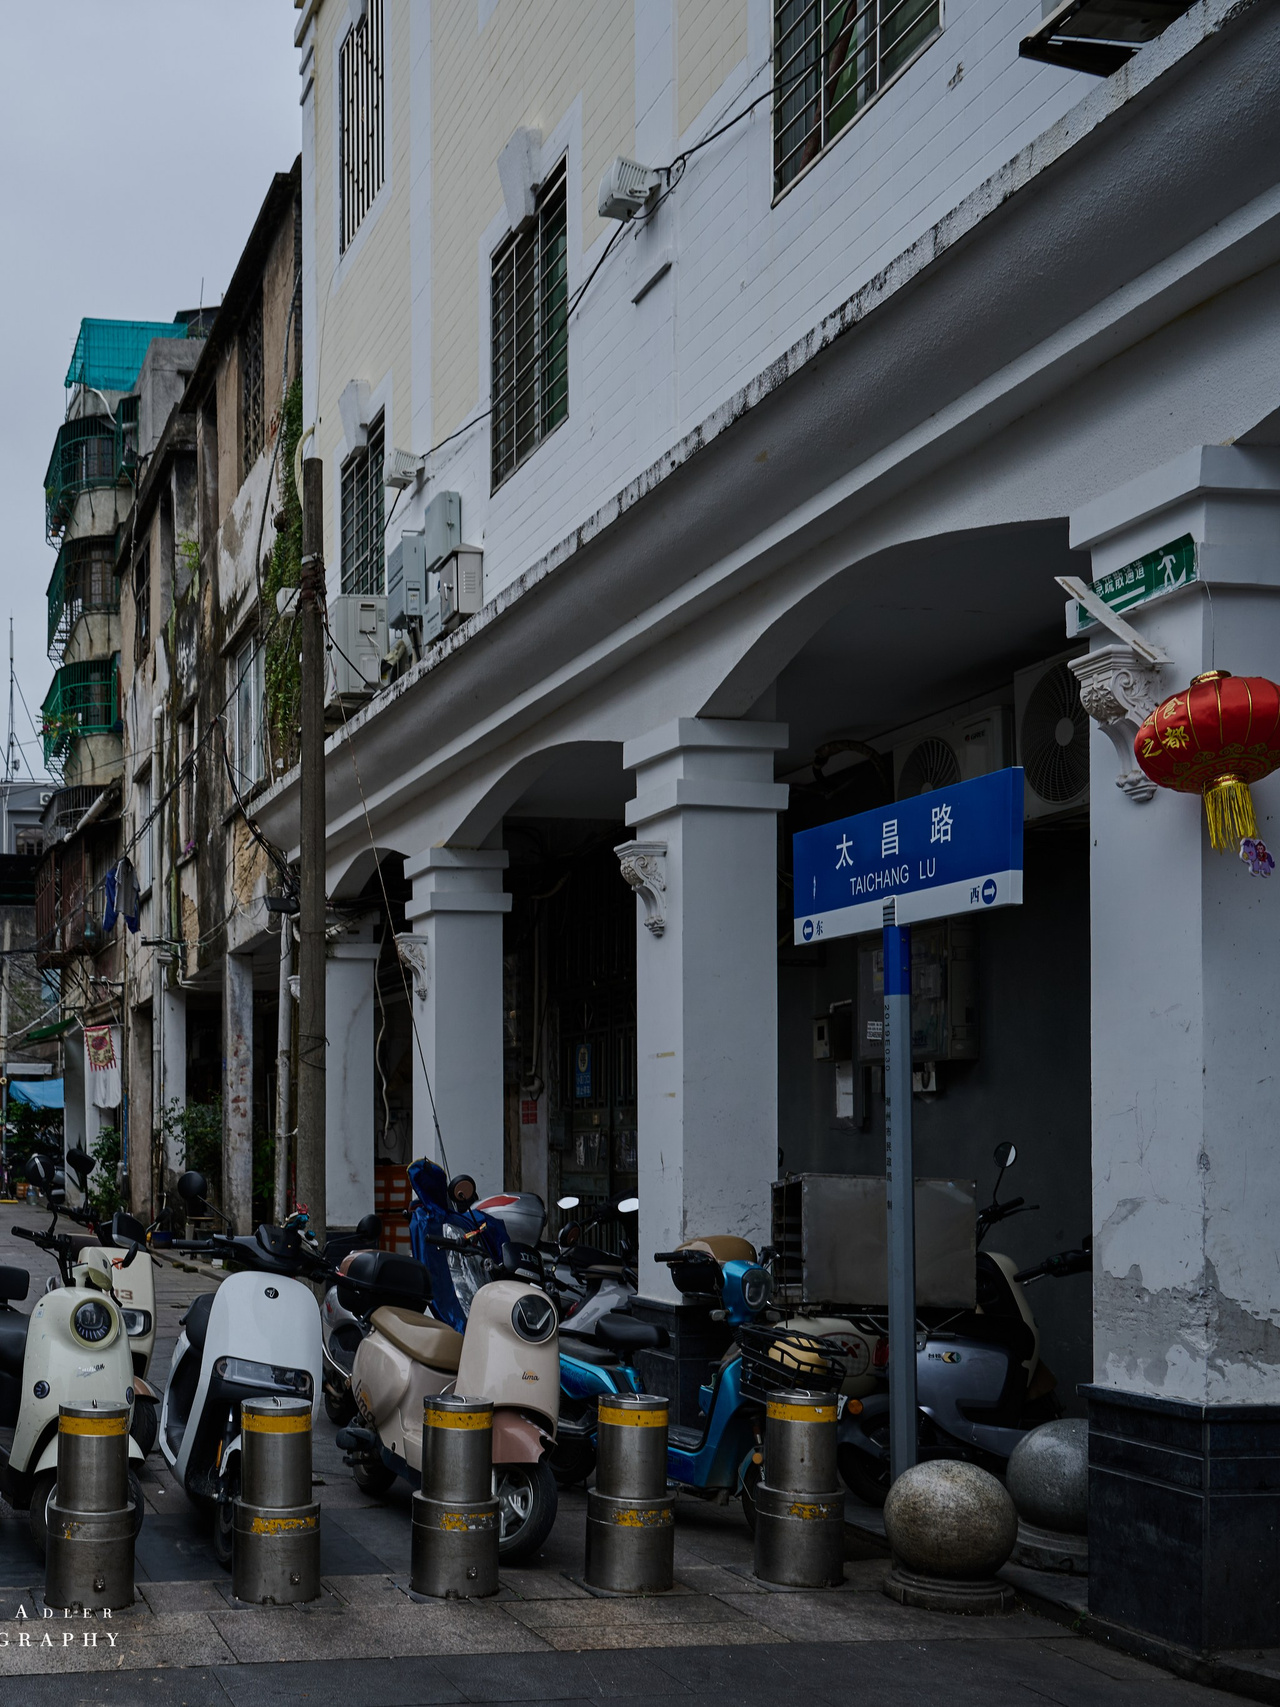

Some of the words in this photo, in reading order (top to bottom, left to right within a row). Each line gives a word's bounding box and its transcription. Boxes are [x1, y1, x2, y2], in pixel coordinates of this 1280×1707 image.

[835, 803, 954, 870] 太昌路
[850, 864, 910, 896] TAICHANG
[919, 857, 937, 880] LU
[970, 885, 980, 904] 西
[815, 920, 824, 936] 东
[522, 1371, 539, 1381] lima
